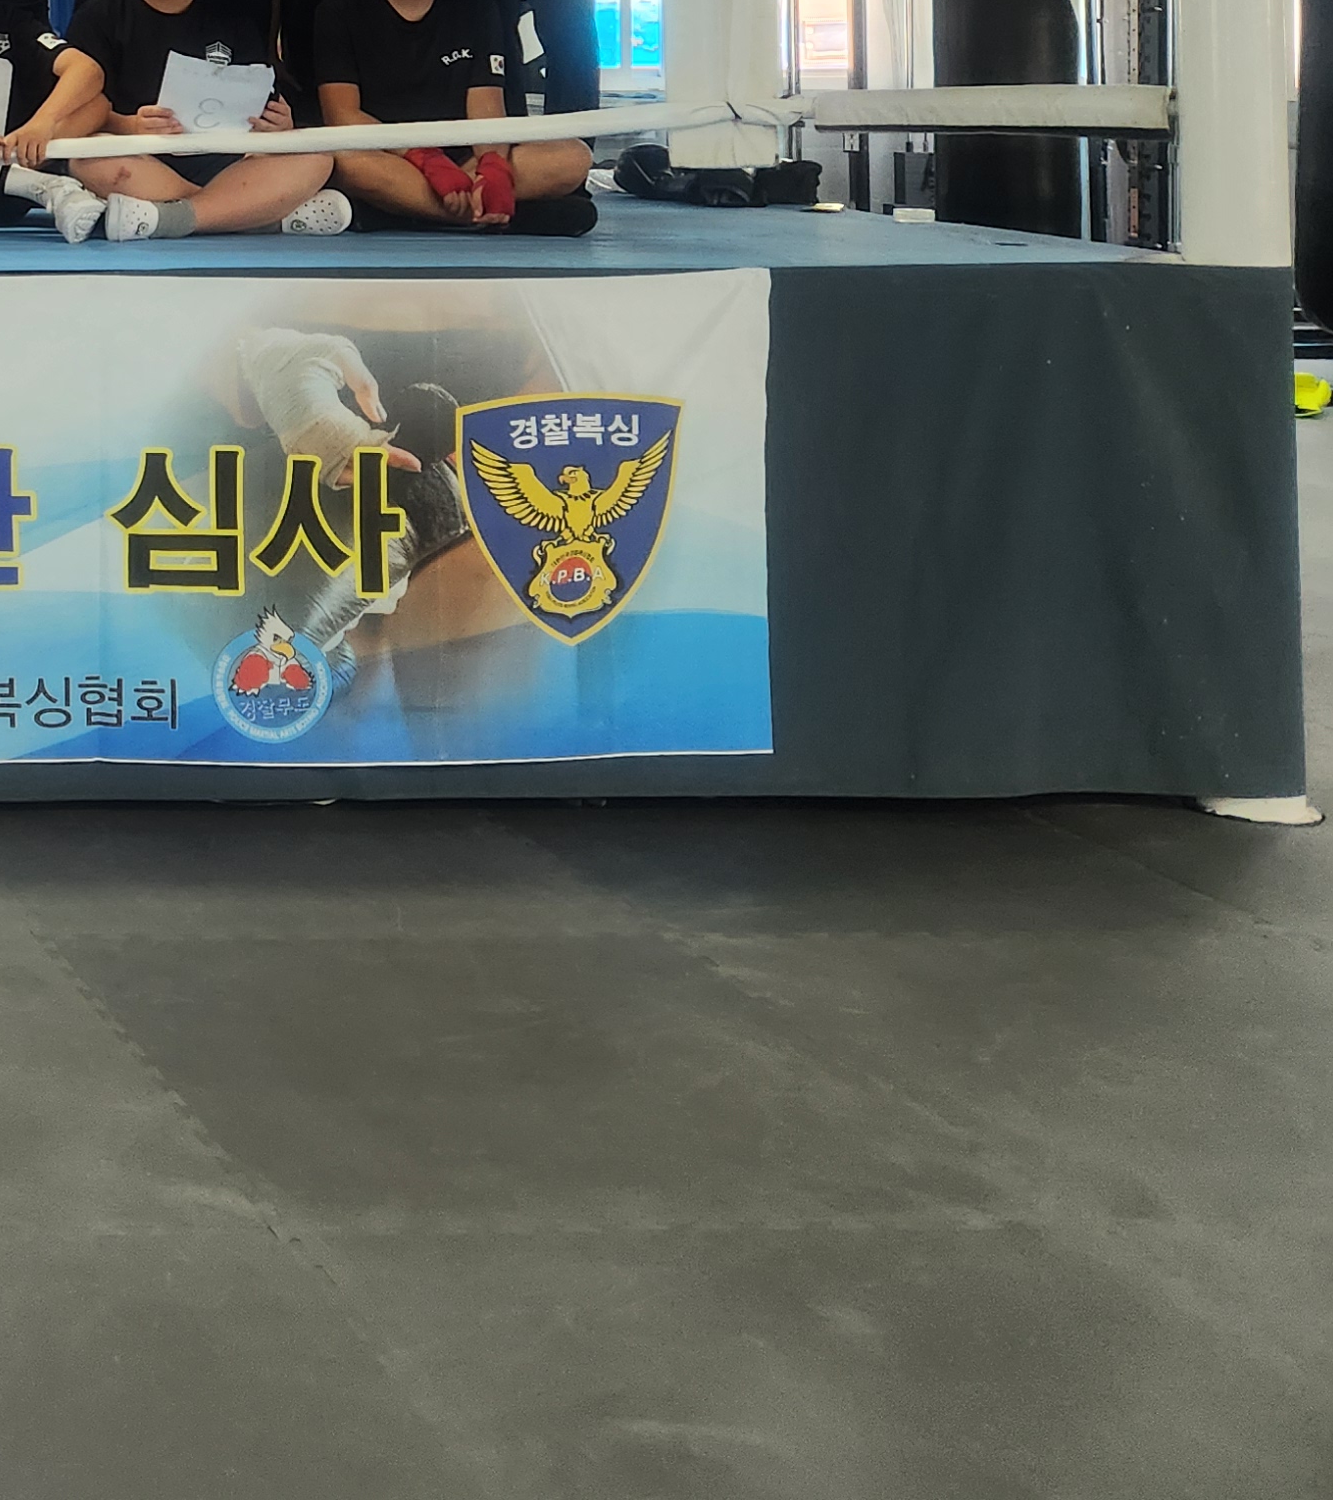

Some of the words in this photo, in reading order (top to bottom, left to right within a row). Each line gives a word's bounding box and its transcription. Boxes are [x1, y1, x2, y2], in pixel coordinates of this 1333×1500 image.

[509, 413, 640, 449] 경찰복싱
[105, 444, 409, 598] 심사
[239, 697, 310, 721] 경찰무도
